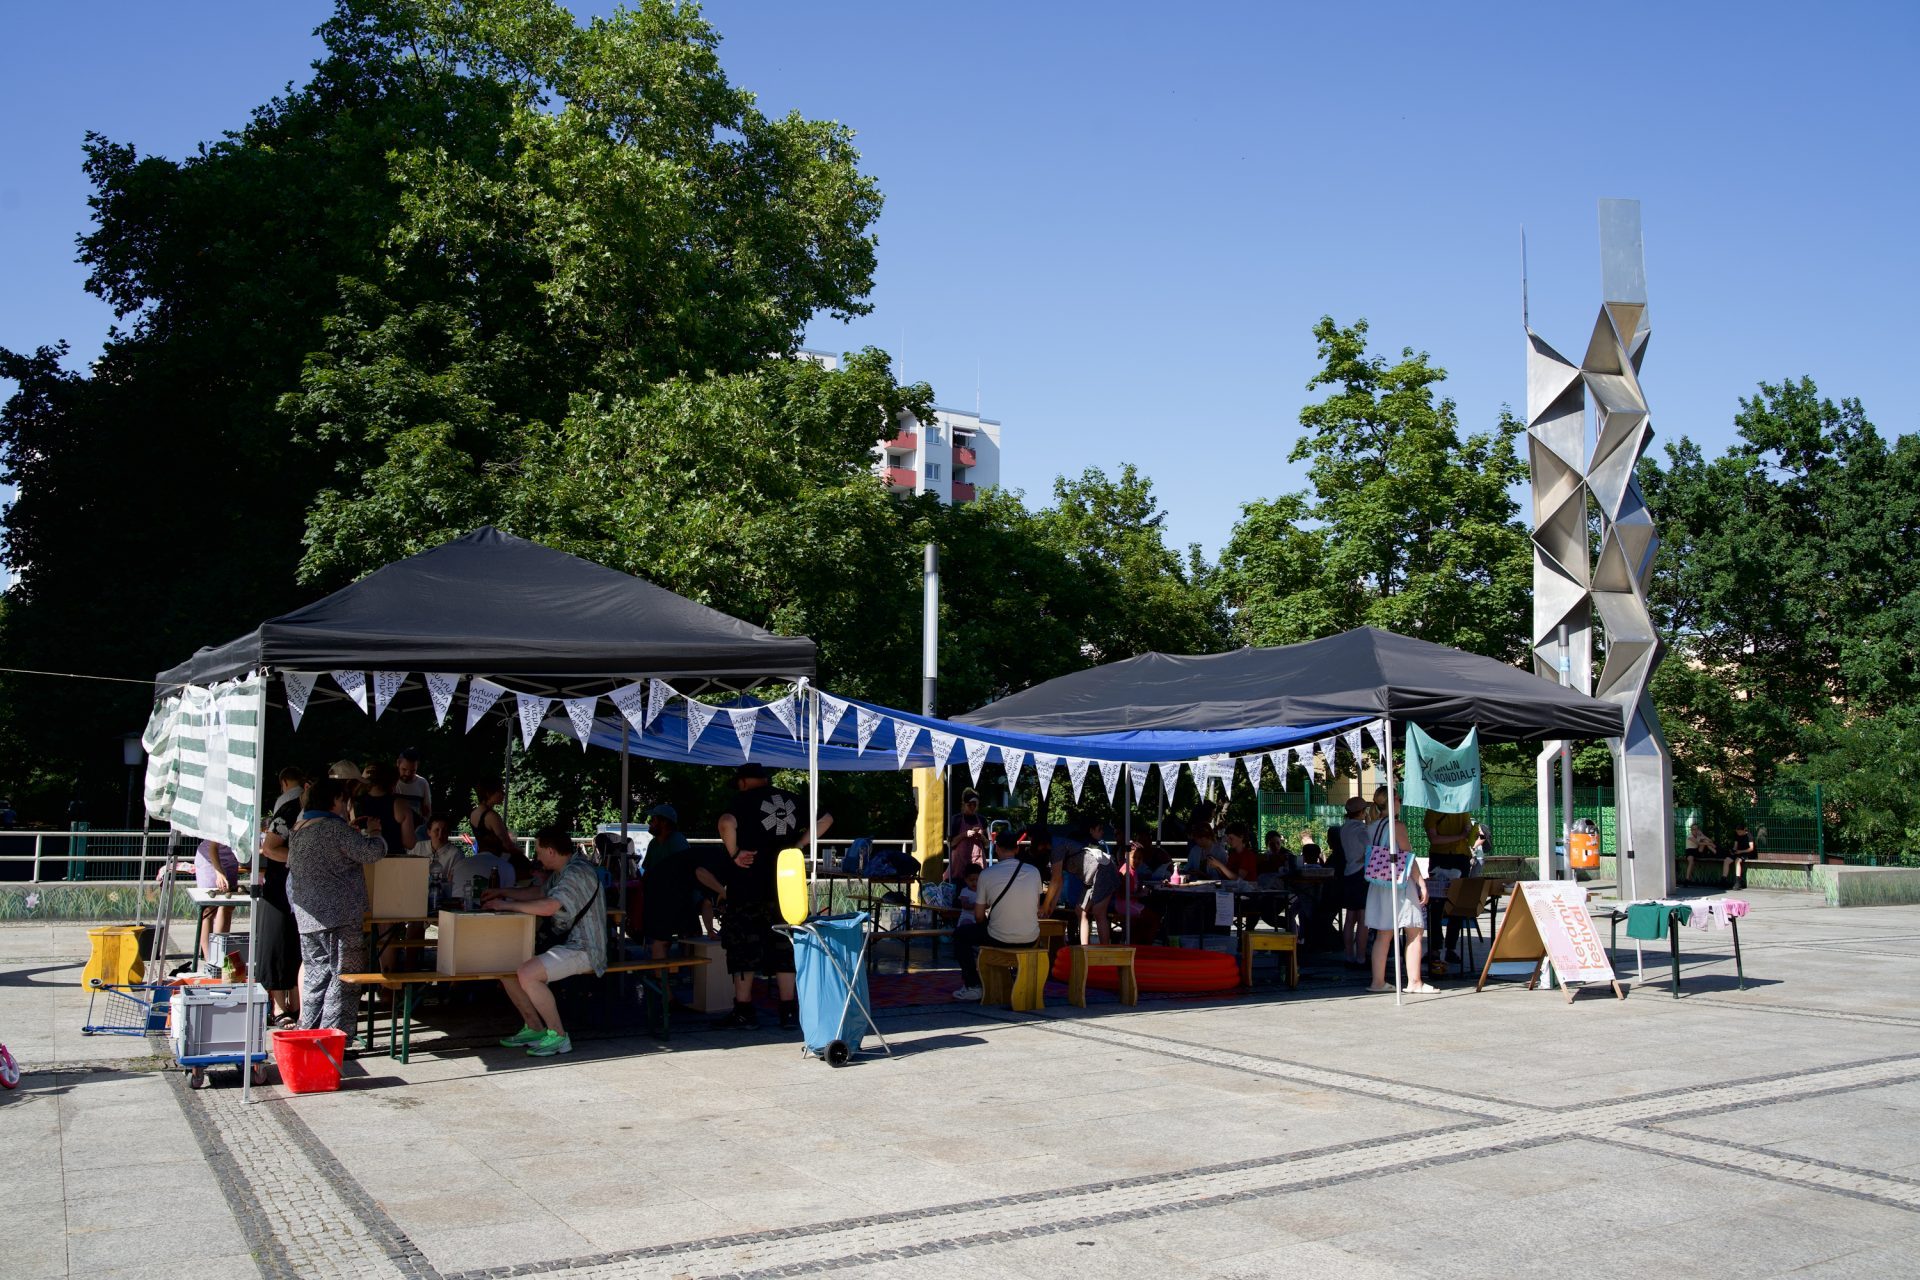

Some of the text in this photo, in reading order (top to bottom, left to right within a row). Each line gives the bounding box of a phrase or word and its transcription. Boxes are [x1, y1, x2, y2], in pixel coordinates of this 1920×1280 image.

[1434, 768, 1476, 782] MONDIALE
[1552, 894, 1590, 970] keramik
[1568, 906, 1604, 969] festival
